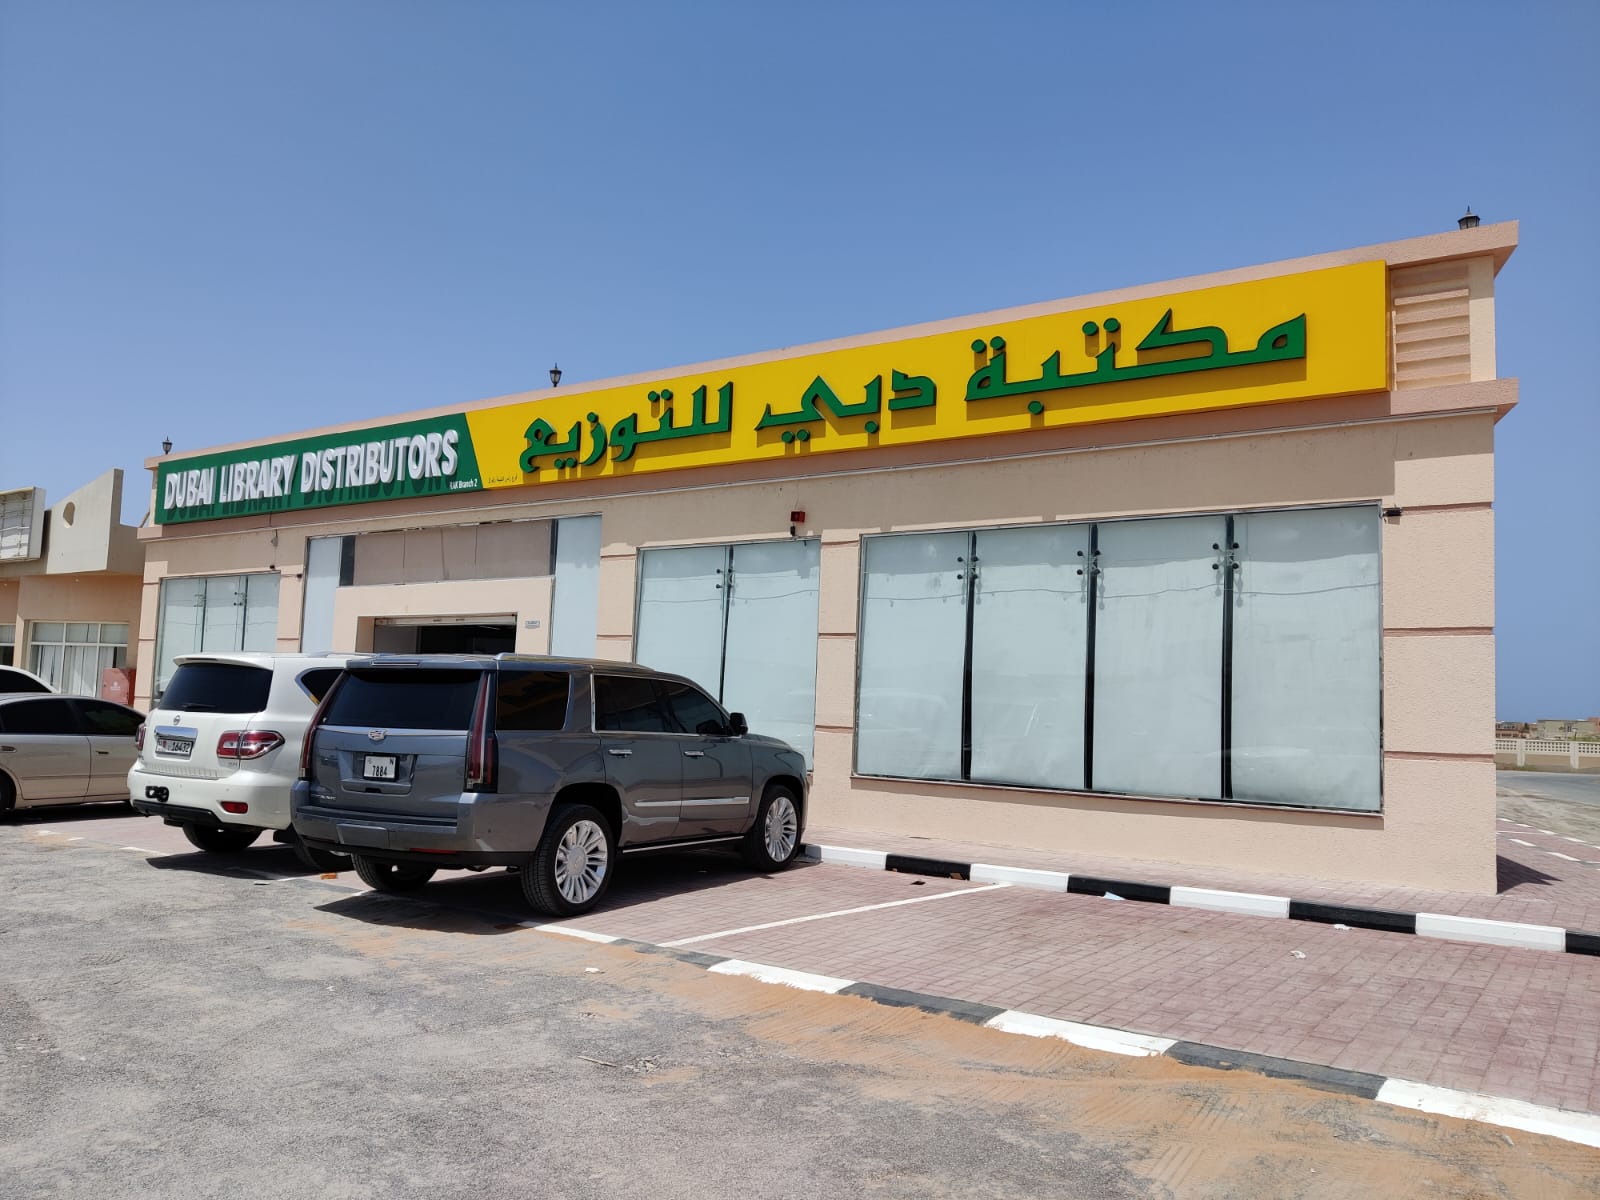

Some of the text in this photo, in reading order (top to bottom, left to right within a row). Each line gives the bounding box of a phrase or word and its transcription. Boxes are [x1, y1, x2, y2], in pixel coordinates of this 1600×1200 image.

[519, 308, 1307, 473] مكتبة دبي للتوزيع
[164, 429, 459, 510] DUBAI LIBRARY DISTRIBUTORS
[459, 478, 474, 489] Branch
